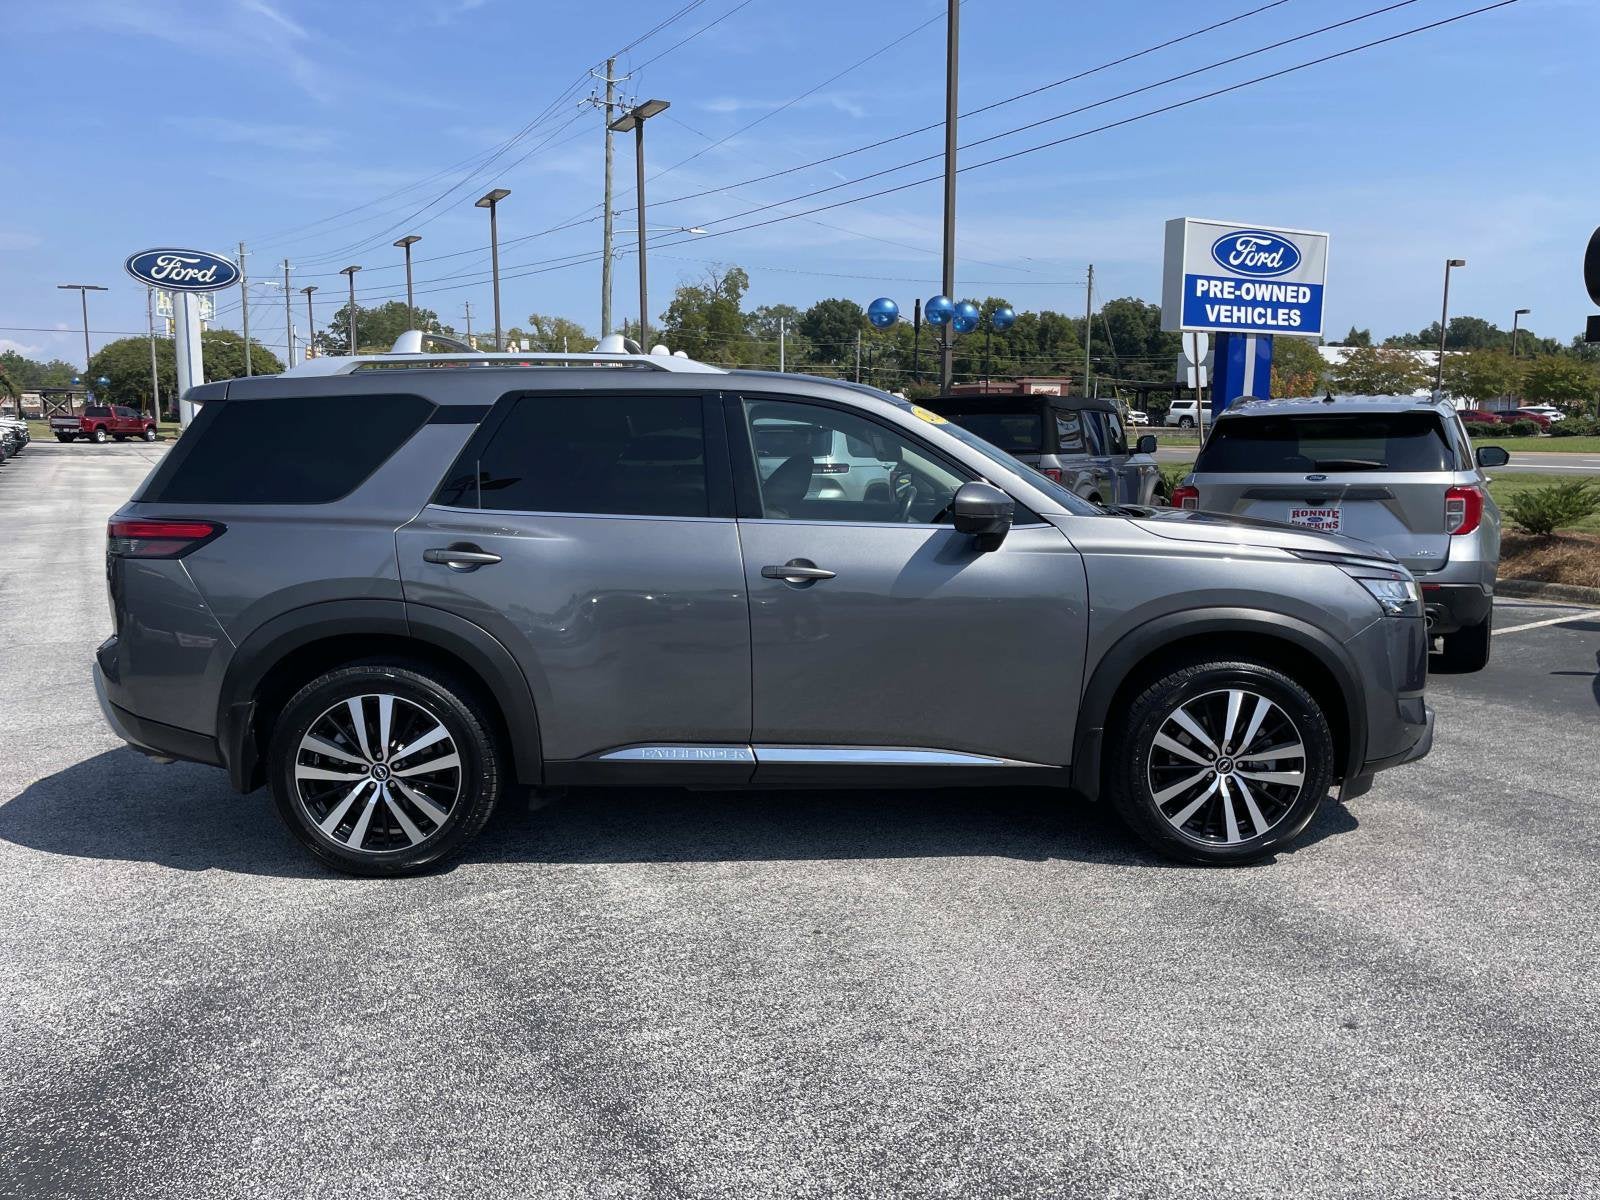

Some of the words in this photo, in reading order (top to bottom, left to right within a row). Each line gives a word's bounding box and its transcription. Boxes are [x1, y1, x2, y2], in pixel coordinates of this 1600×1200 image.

[1229, 236, 1285, 268] Ford
[150, 255, 217, 282] Ford
[1196, 279, 1311, 304] PRE-OWNED
[1205, 304, 1301, 327] VEHICLES
[1291, 510, 1340, 519] RONNIE
